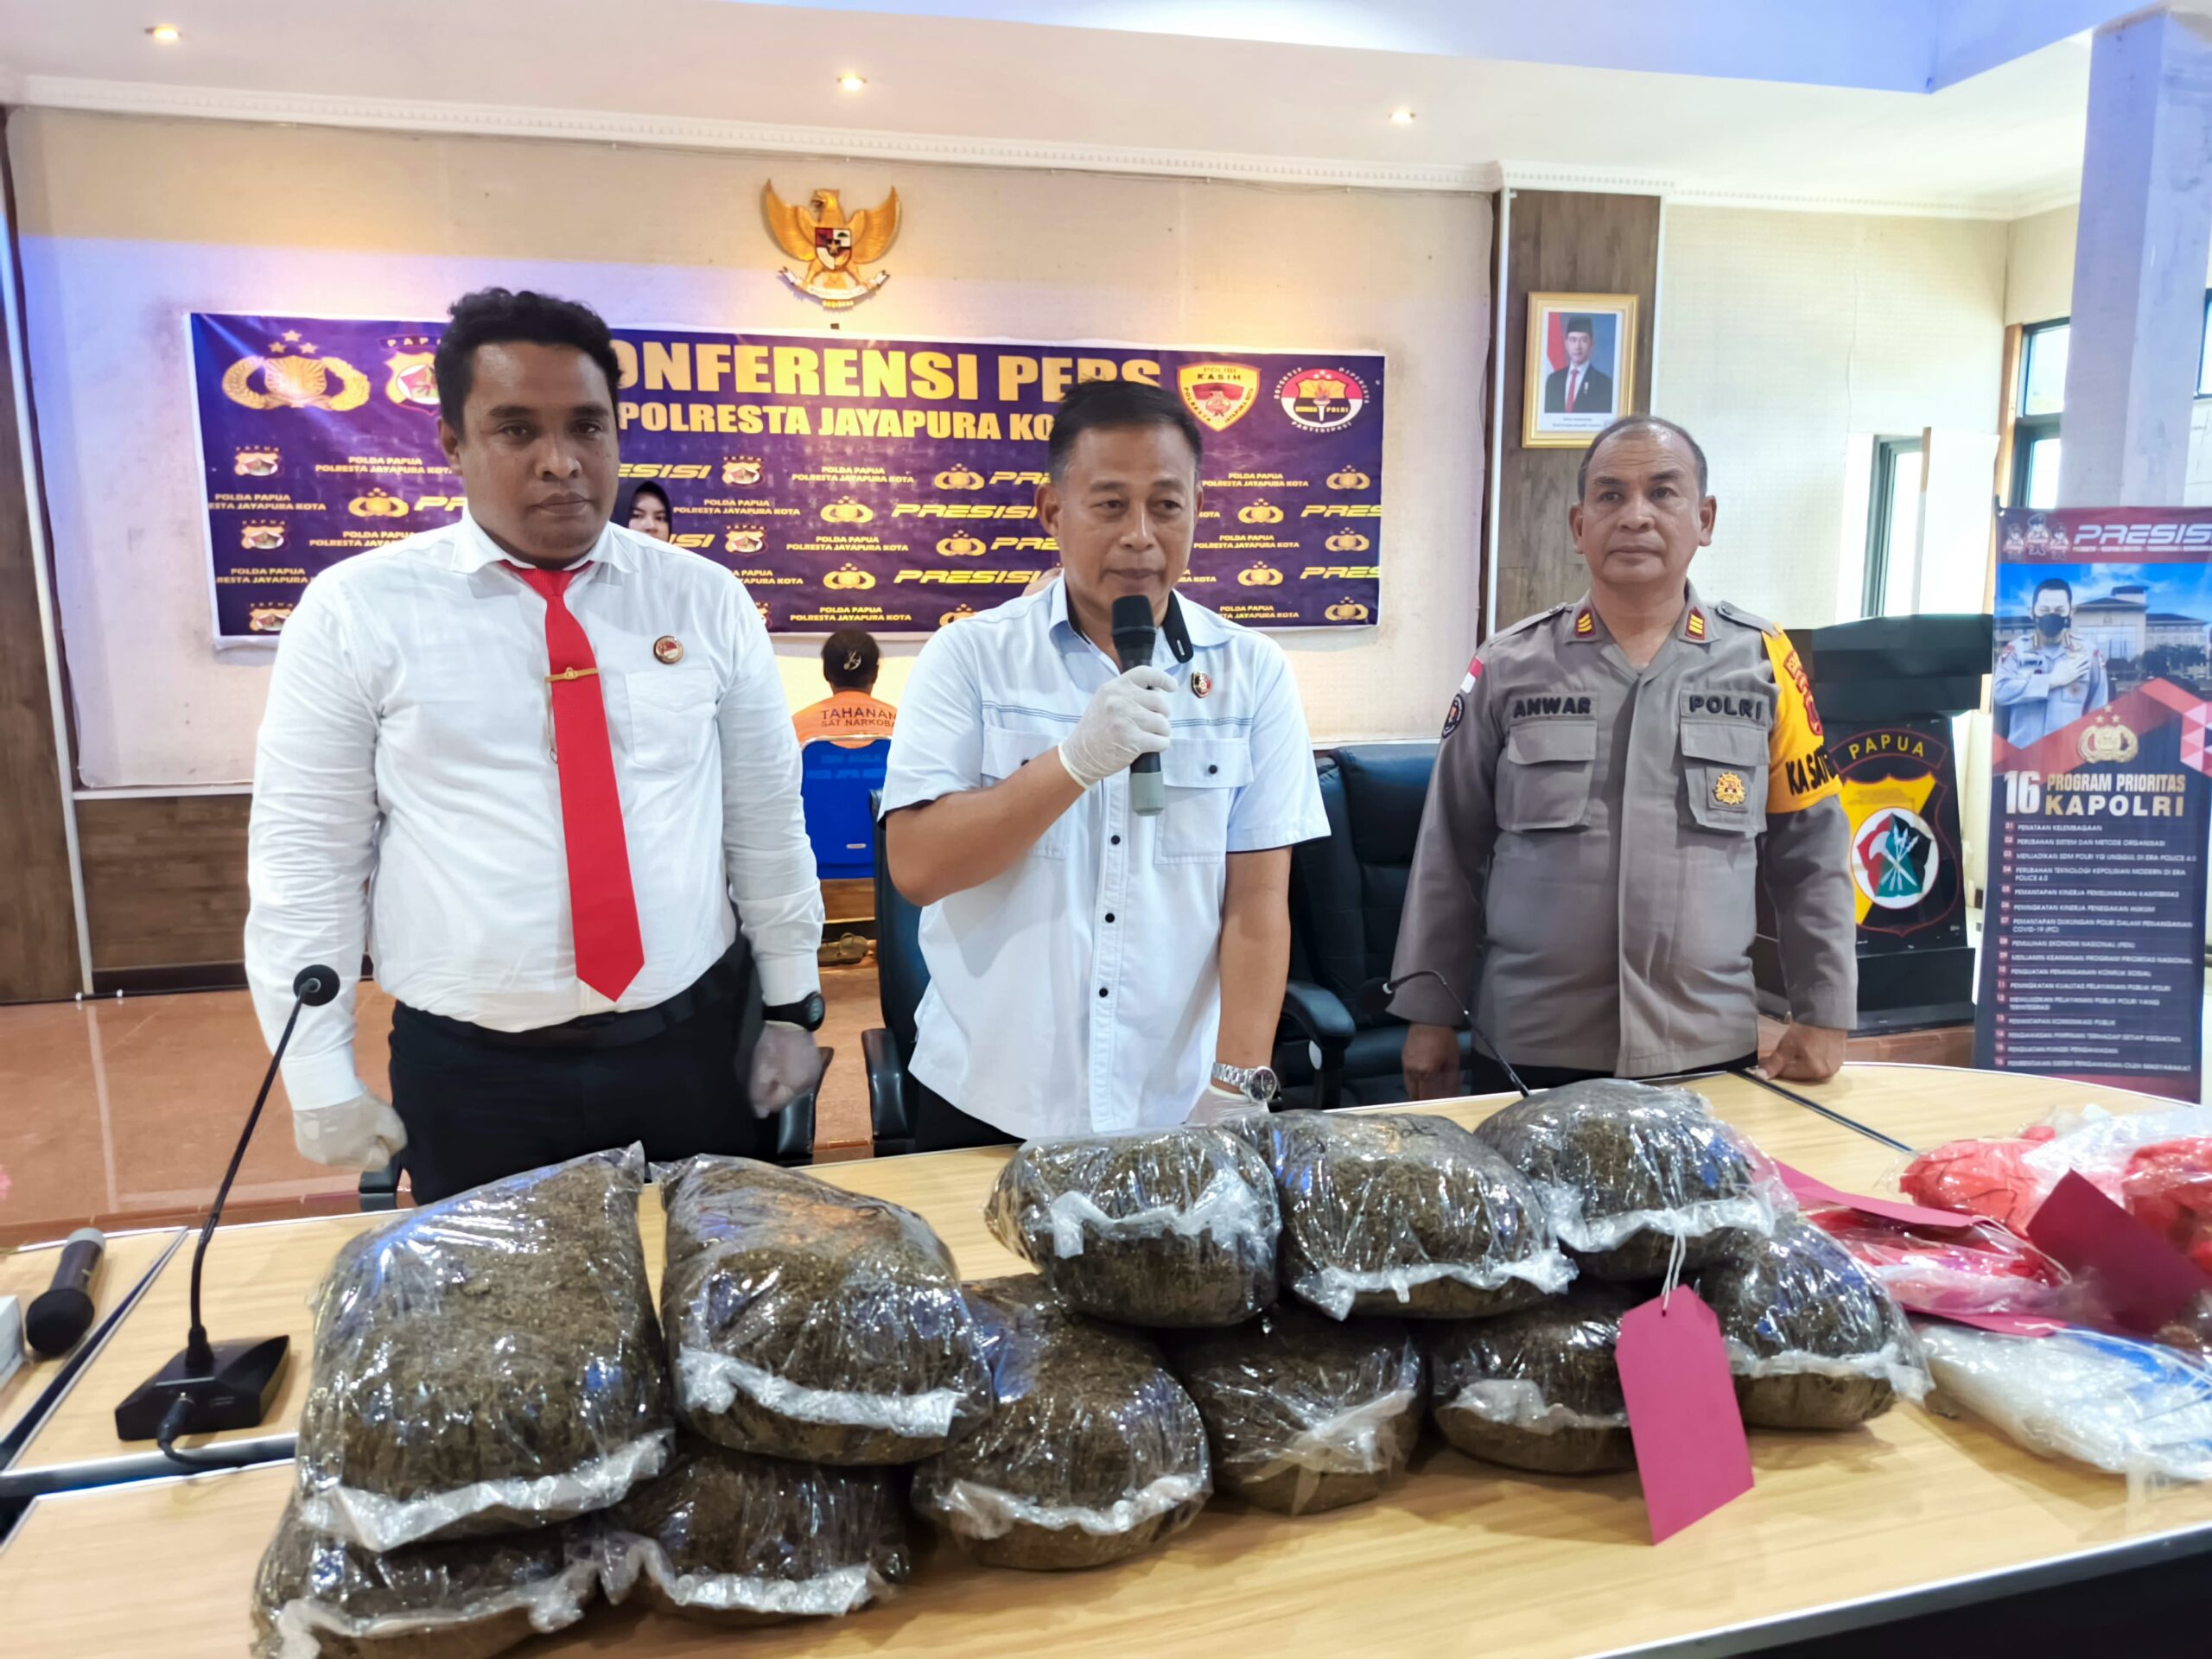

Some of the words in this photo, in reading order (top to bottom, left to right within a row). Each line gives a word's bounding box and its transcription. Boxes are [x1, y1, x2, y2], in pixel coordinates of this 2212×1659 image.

[387, 338, 441, 346] PAP
[609, 340, 978, 400] ONFERENSI
[1184, 387, 1211, 423] POLRESTA
[619, 402, 811, 435] POLRESTA
[817, 407, 1001, 440] JAYAPURA
[1009, 413, 1054, 441] KO
[618, 464, 711, 479] ESISI
[892, 504, 1038, 518] PRESISI
[1300, 505, 1382, 517] PRES
[2074, 524, 2212, 544] PRESIS
[893, 570, 1042, 583] PRESISI
[1300, 567, 1381, 579] PRES
[821, 707, 897, 720] TAHANAN
[1513, 696, 1592, 719] ANWAR
[1689, 695, 1763, 720] POLRI
[822, 719, 840, 728] SAT
[1848, 734, 1923, 760] PAPUA
[2004, 771, 2040, 814] 16
[2047, 774, 2112, 791] PROGRAM
[2117, 774, 2186, 792] PRIORITAS
[2045, 795, 2184, 817] KAPOLRI
